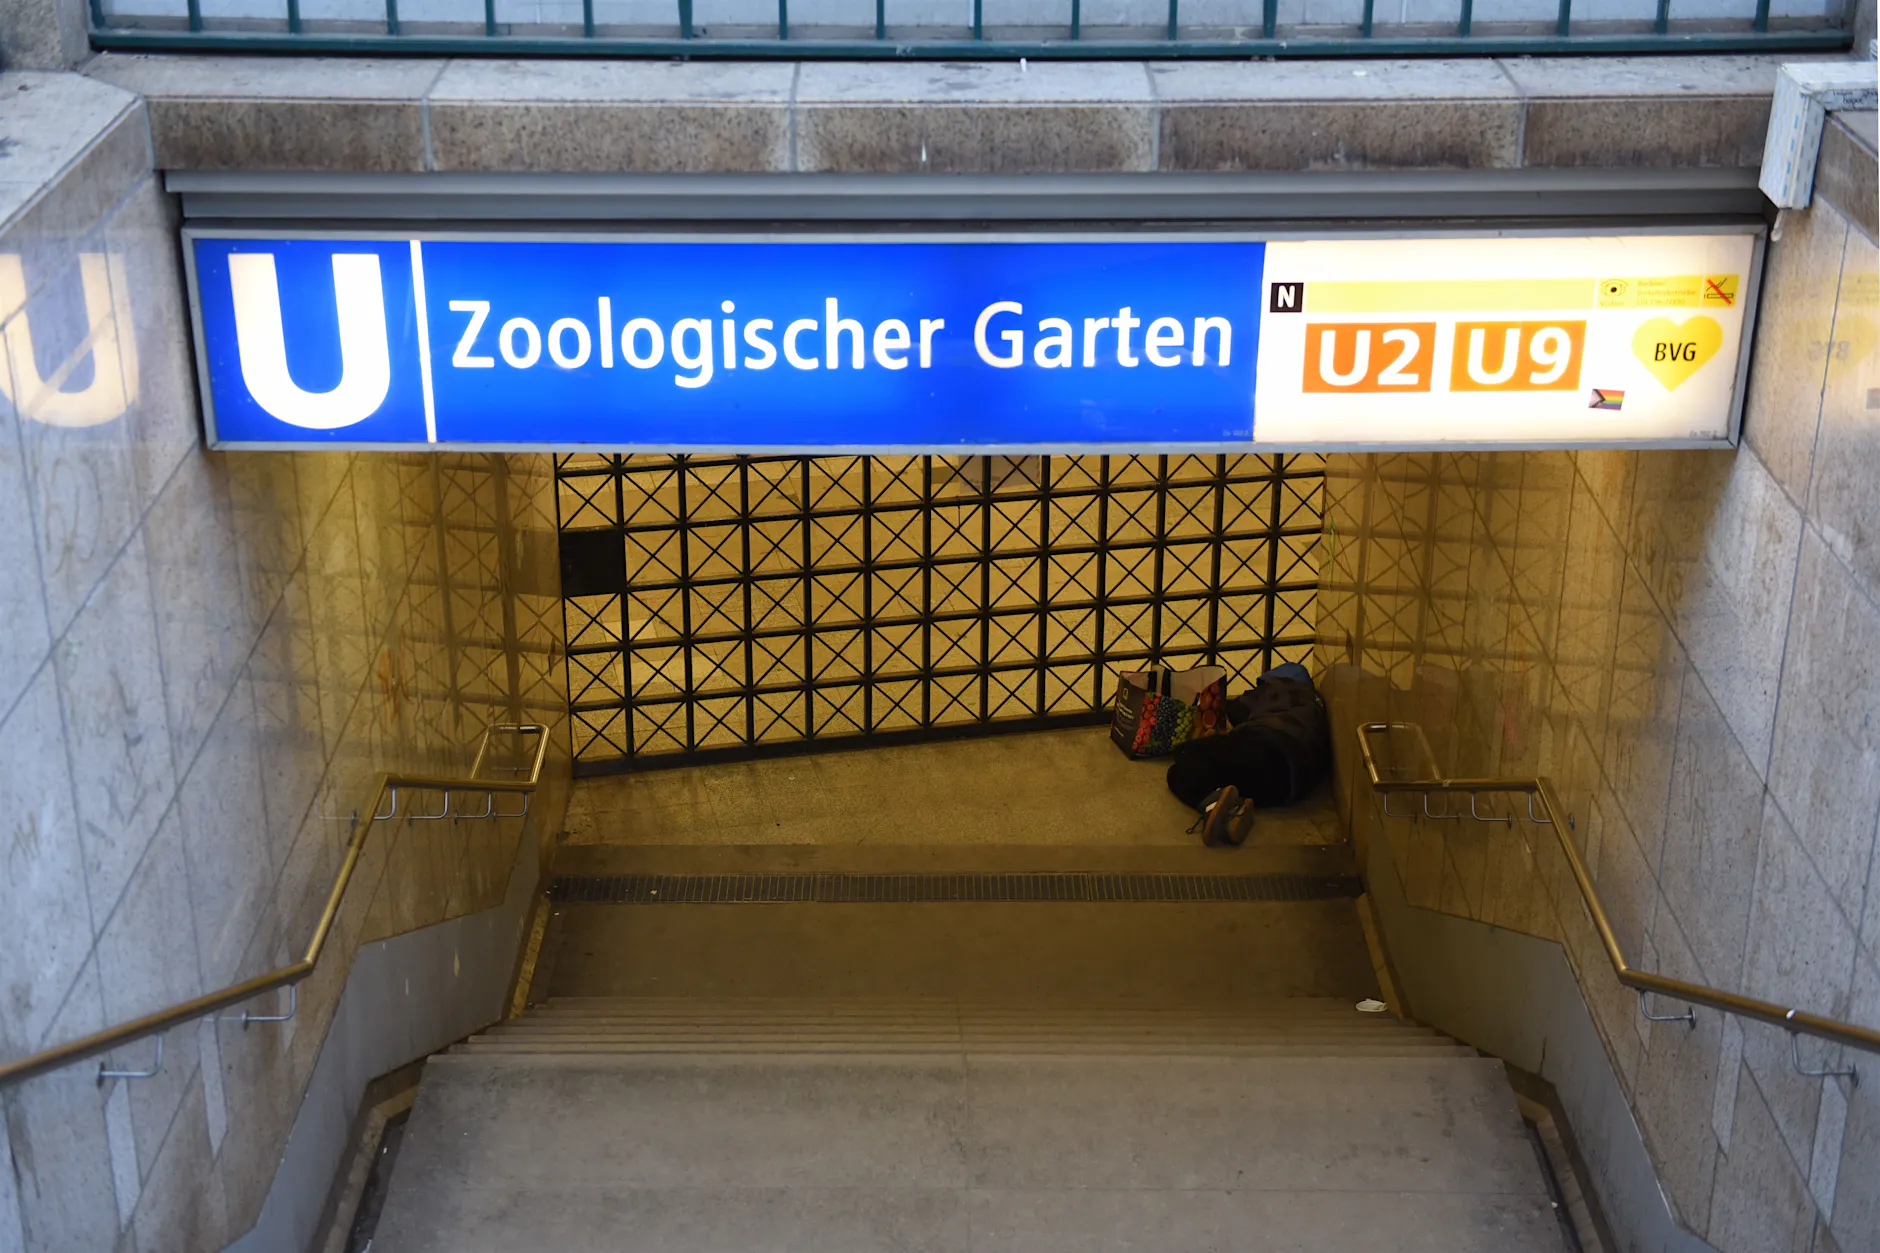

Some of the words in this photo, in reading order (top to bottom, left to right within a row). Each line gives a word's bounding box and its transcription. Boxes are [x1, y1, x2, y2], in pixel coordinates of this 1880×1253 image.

[1276, 284, 1297, 309] N
[227, 253, 391, 430] U
[448, 296, 945, 389] Zoologischer
[974, 300, 1232, 369] Garten
[1318, 328, 1421, 387] U2
[1466, 326, 1573, 385] U9
[1654, 342, 1697, 362] BVG
